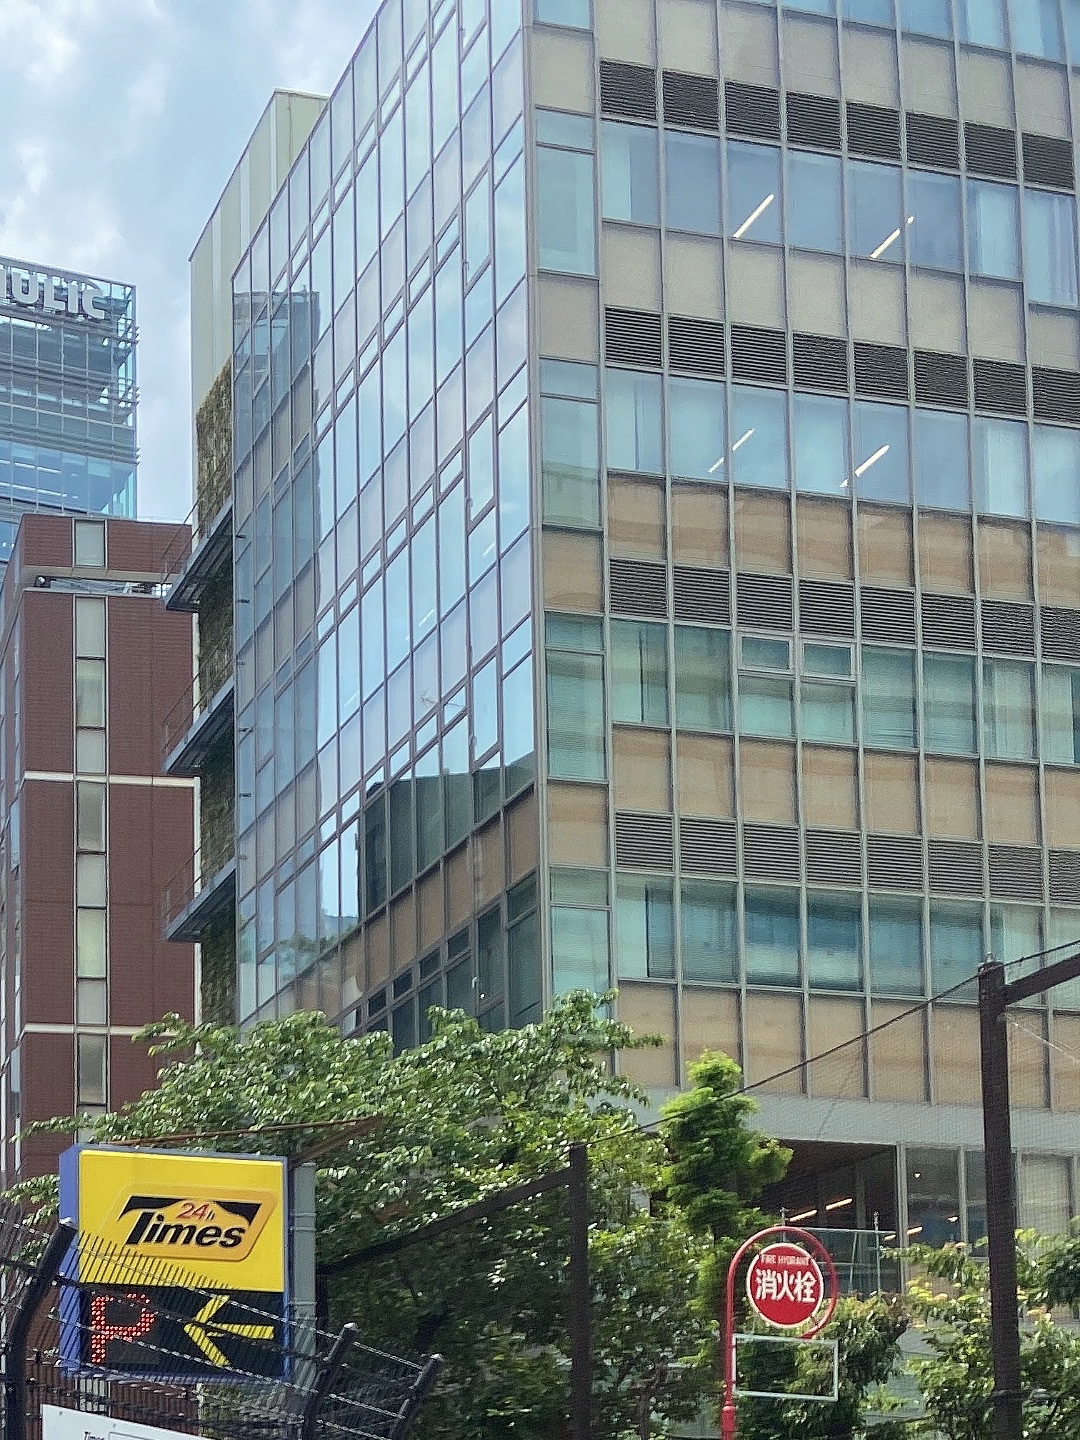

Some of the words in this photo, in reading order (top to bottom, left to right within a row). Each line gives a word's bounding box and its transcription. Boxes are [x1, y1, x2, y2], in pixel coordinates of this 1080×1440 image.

[118, 1198, 247, 1248] Times
[755, 1268, 818, 1303] 消火栓
[90, 1291, 156, 1365] P
